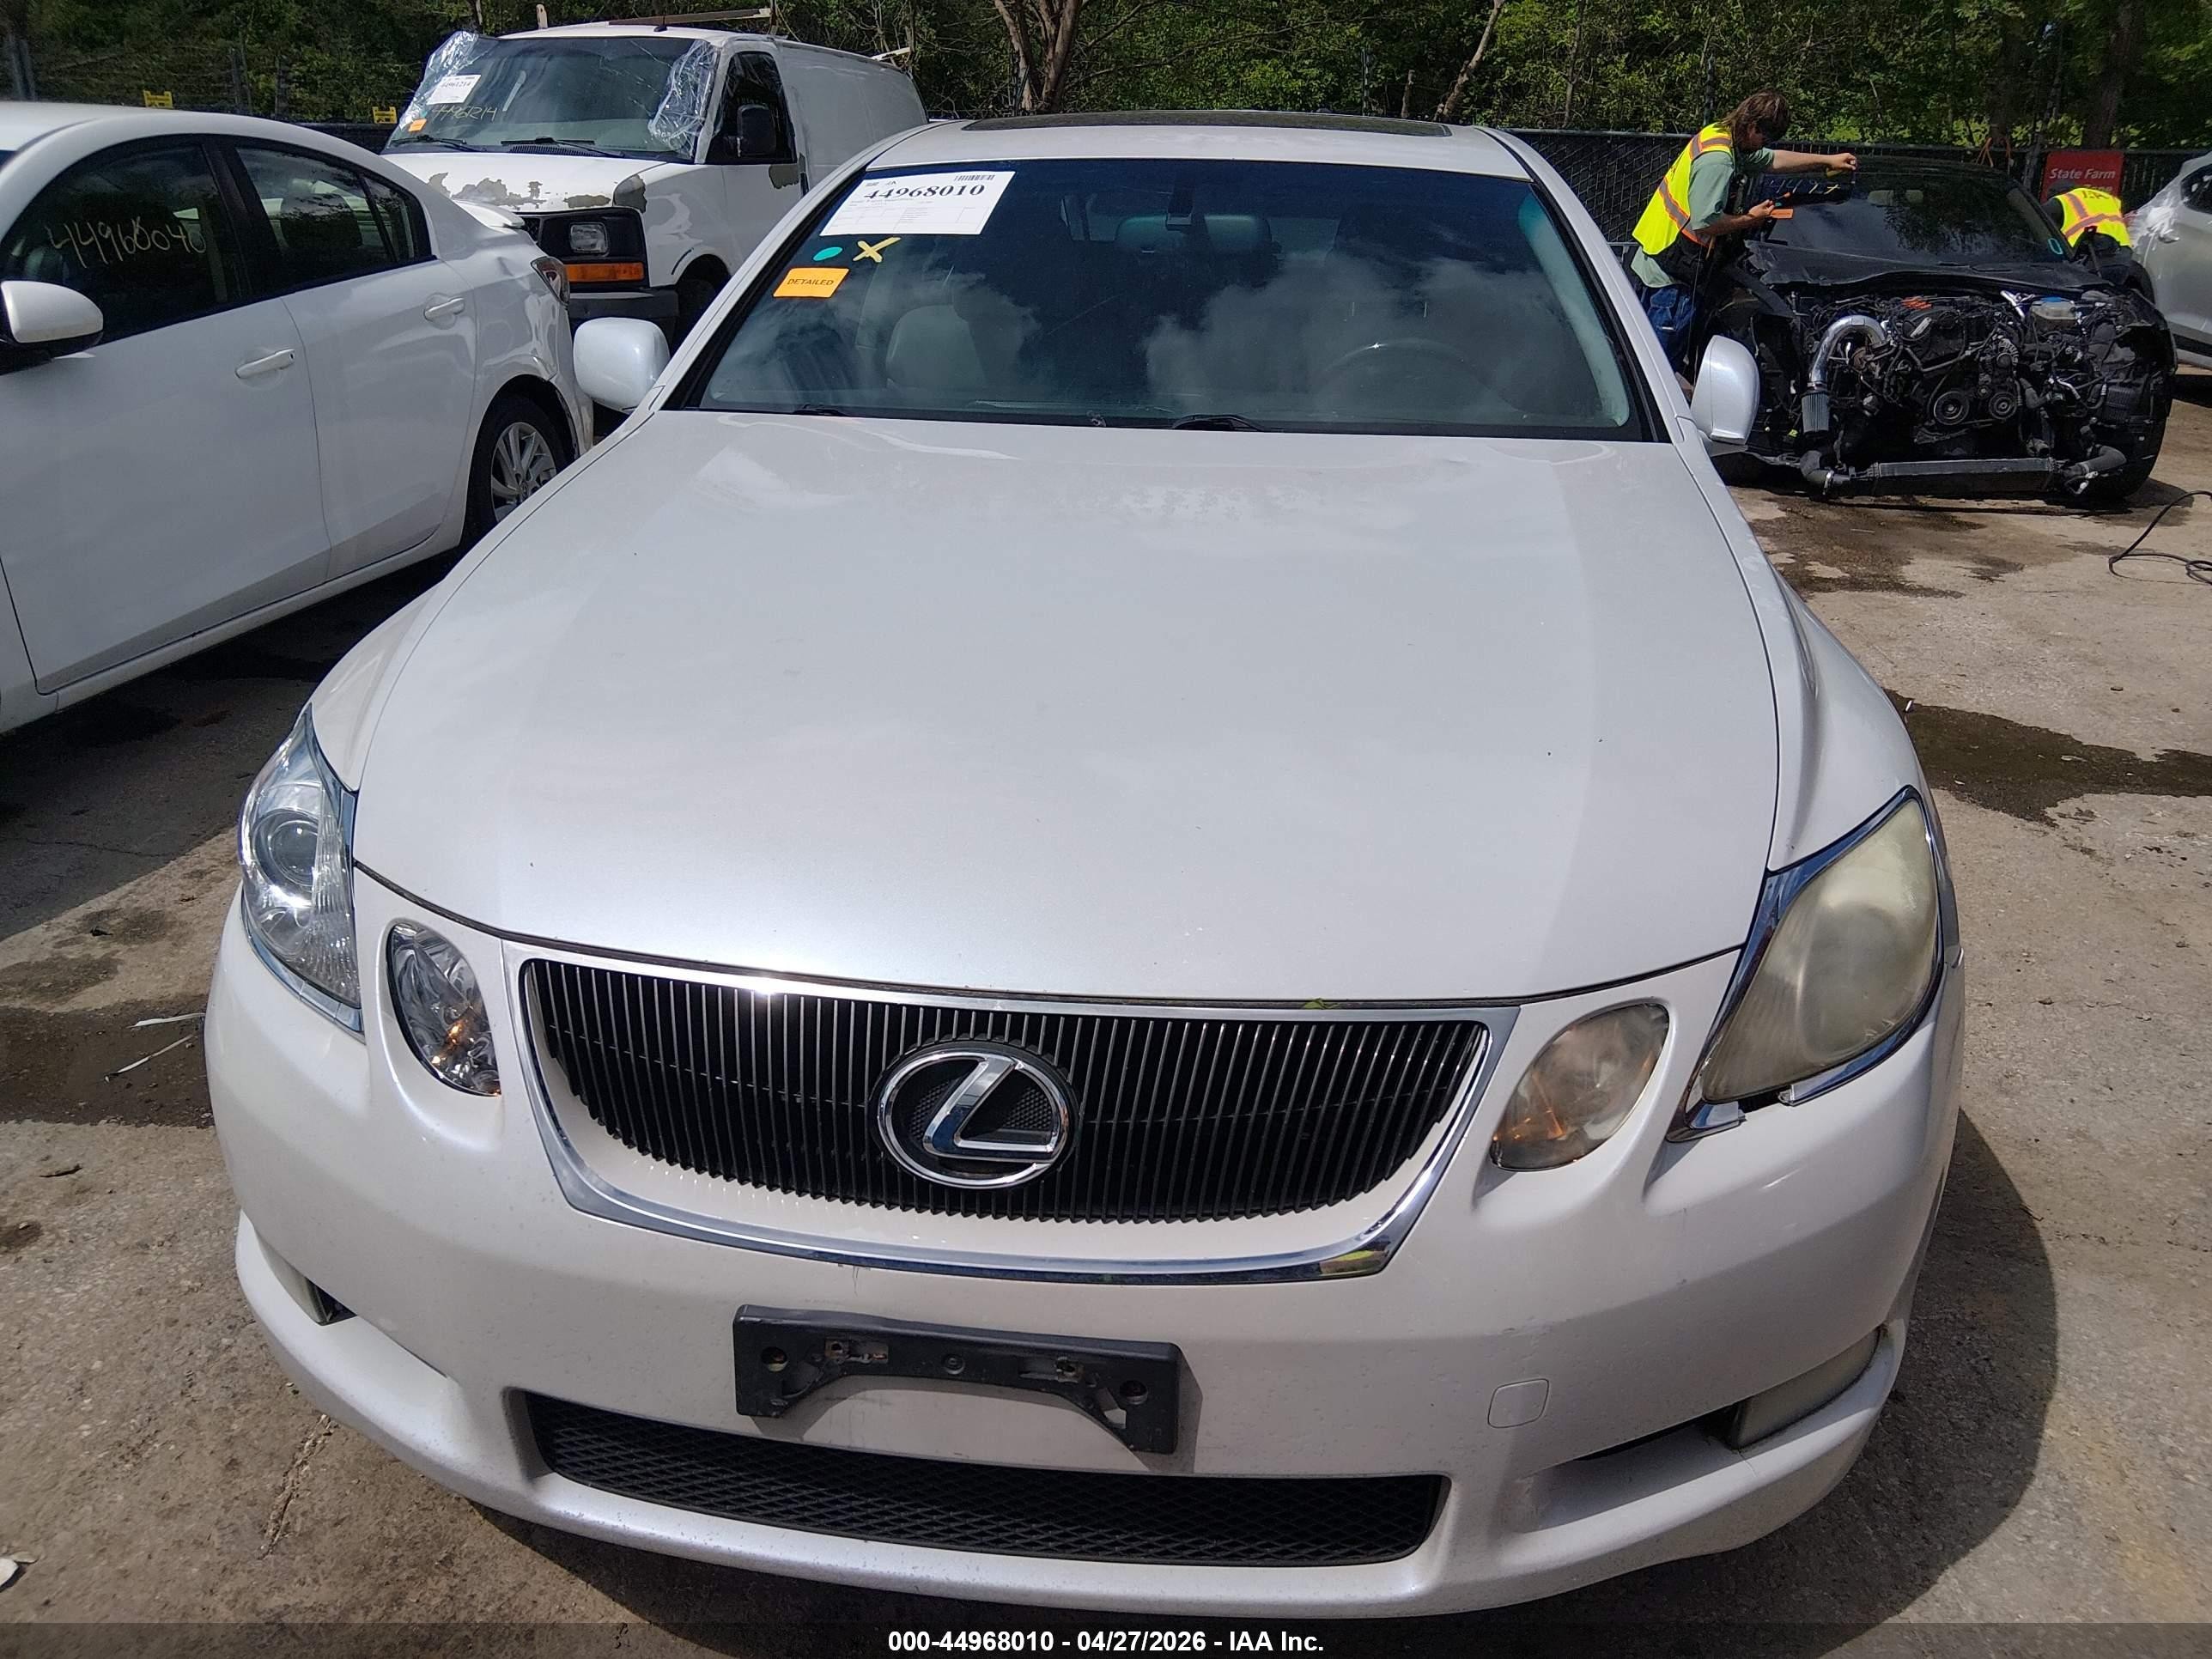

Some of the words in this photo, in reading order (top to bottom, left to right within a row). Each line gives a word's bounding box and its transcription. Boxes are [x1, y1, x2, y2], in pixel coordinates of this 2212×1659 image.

[2050, 167, 2082, 179] State
[2084, 168, 2116, 179] Farm
[864, 184, 986, 199] 44968010
